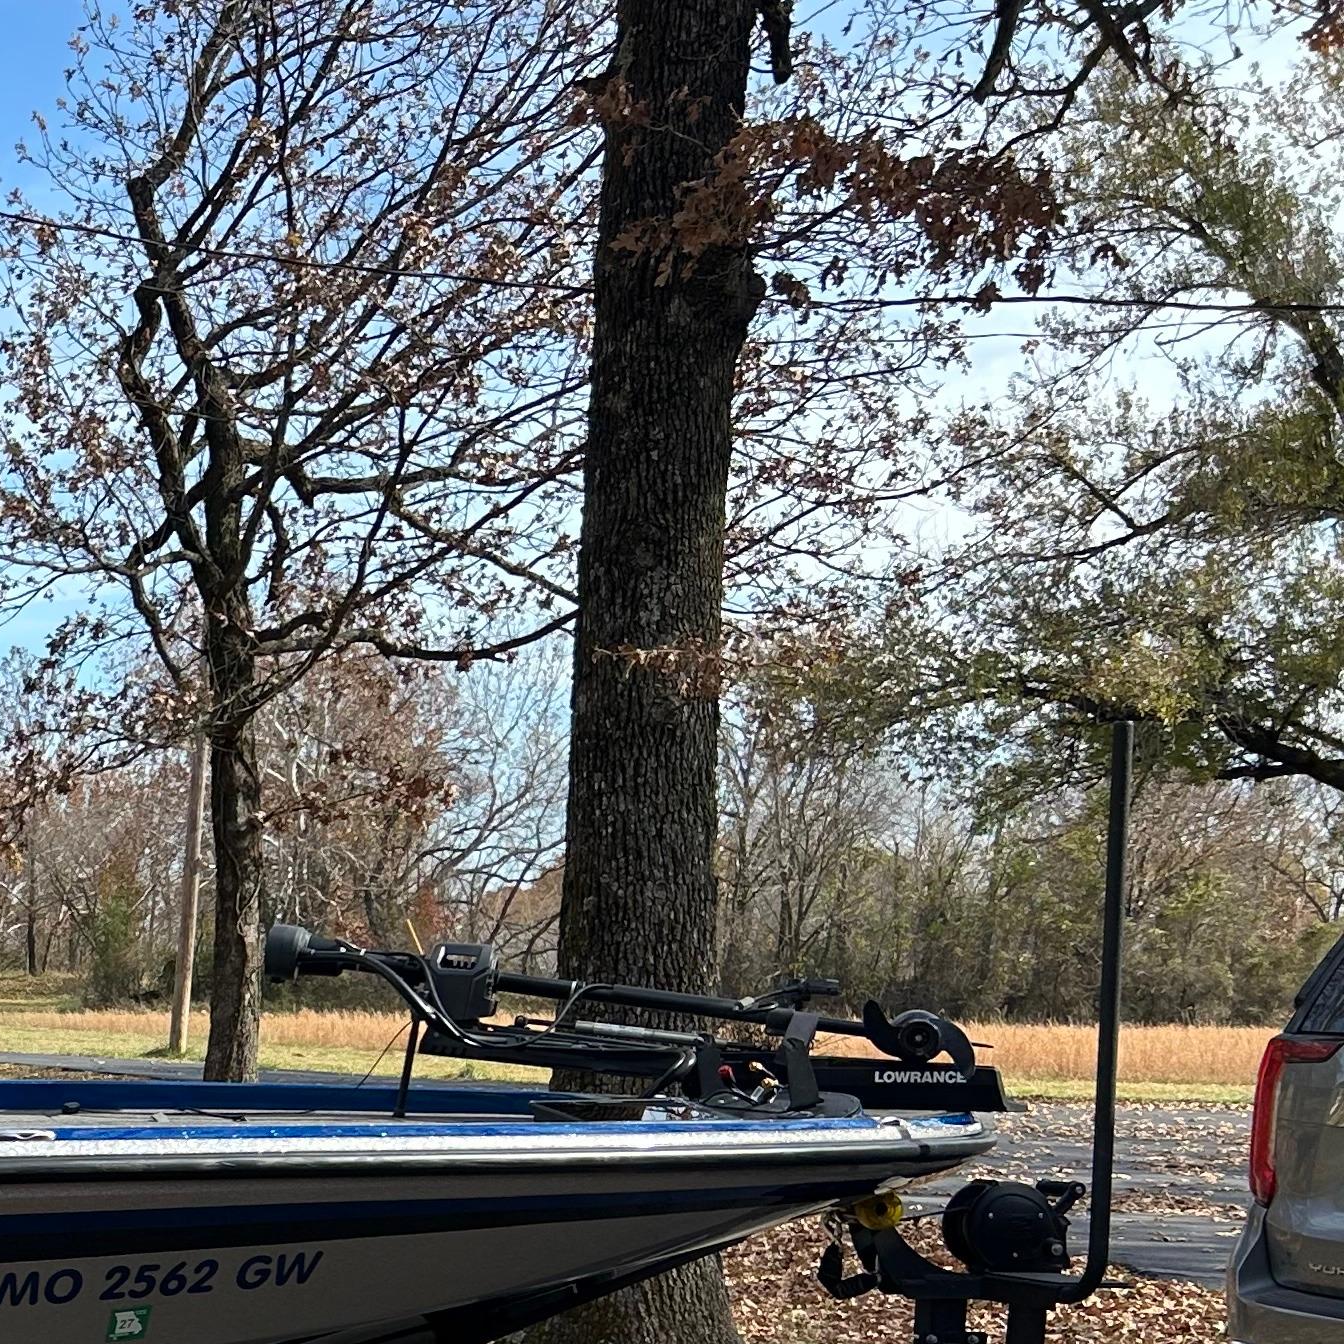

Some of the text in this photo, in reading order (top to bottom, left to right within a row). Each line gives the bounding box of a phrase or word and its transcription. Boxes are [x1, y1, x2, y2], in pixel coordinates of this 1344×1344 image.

[874, 1070, 967, 1083] LOWRANCE
[99, 1258, 219, 1301] 2562
[235, 1250, 324, 1291] GW
[119, 1318, 135, 1330] 27
